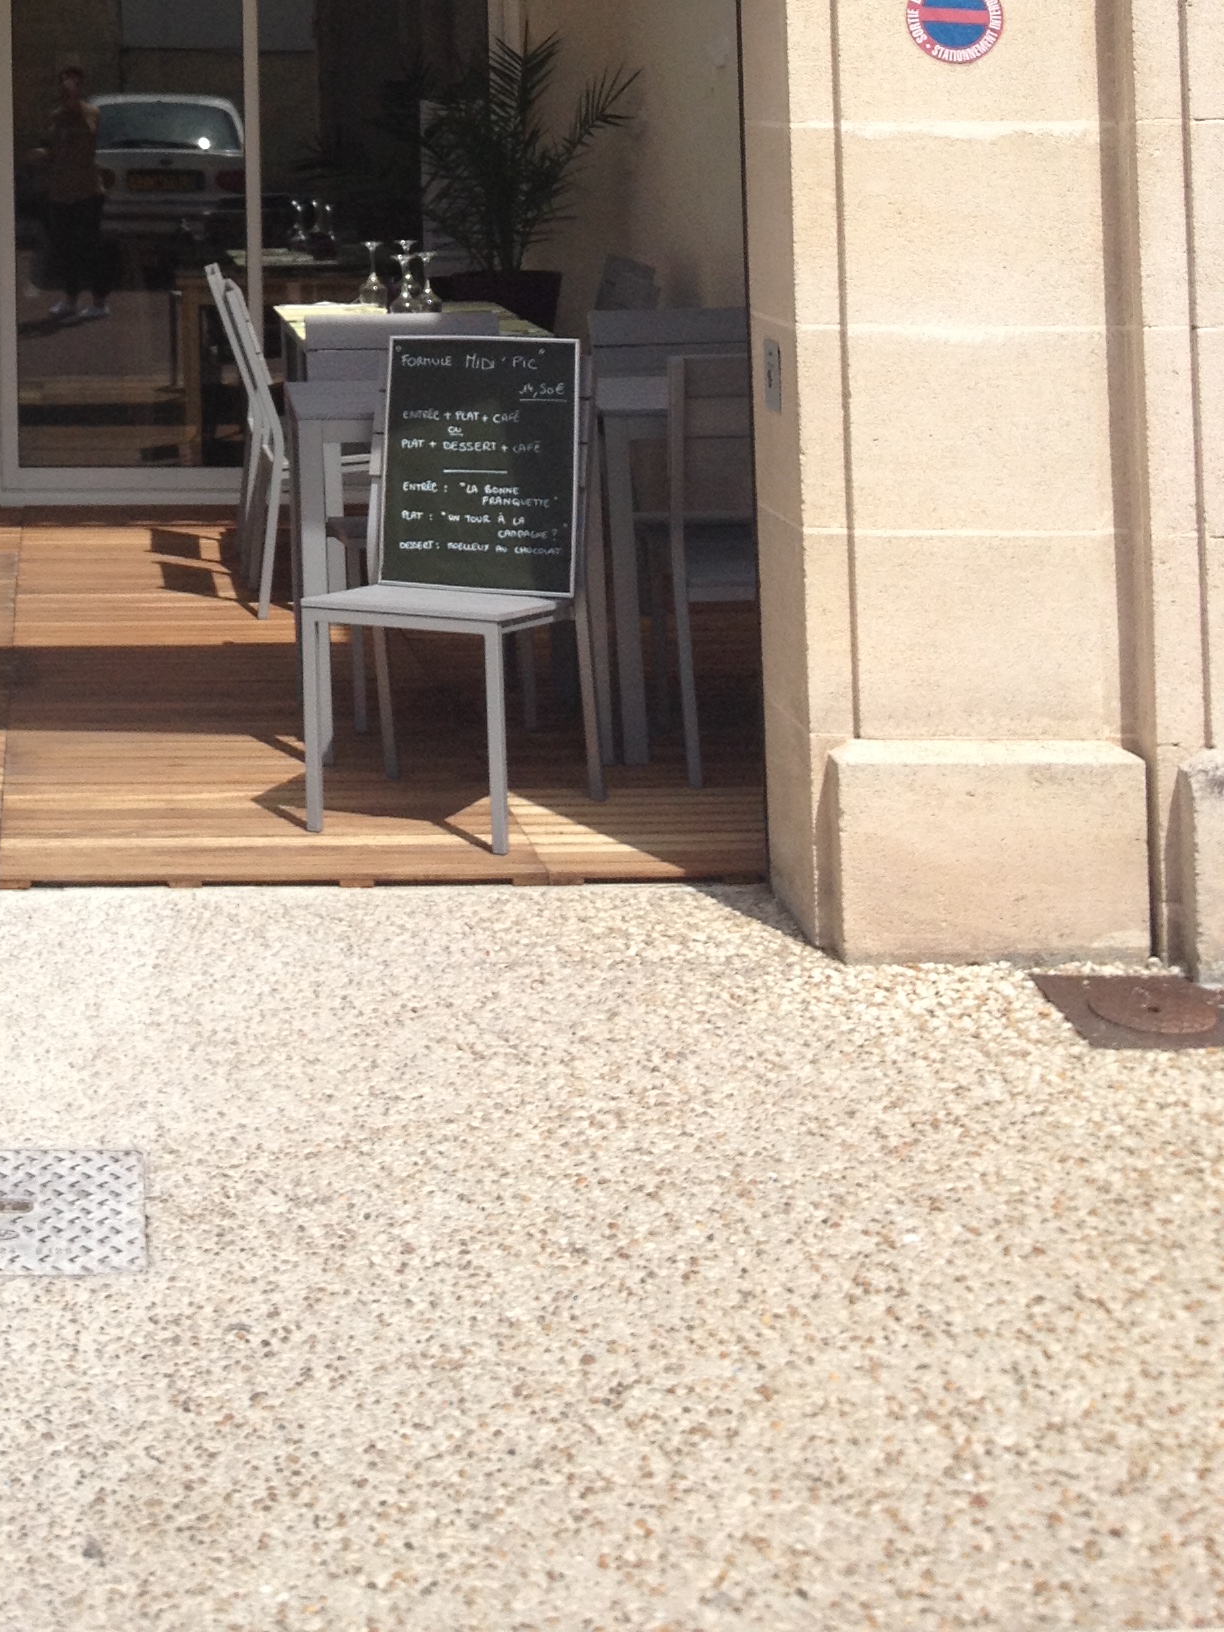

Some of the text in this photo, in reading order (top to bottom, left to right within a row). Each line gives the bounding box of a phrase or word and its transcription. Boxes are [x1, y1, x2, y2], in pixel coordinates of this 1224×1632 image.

[907, 8, 928, 44] SORTIE
[932, 29, 999, 62] STATIONNEMENT
[455, 410, 480, 421] PLAT
[401, 437, 425, 449] PLAT
[442, 441, 497, 452] DESSERT
[484, 485, 520, 495] BONNE
[401, 510, 424, 520] PLAT
[464, 514, 491, 524] TOUR
[512, 516, 525, 526] LA
